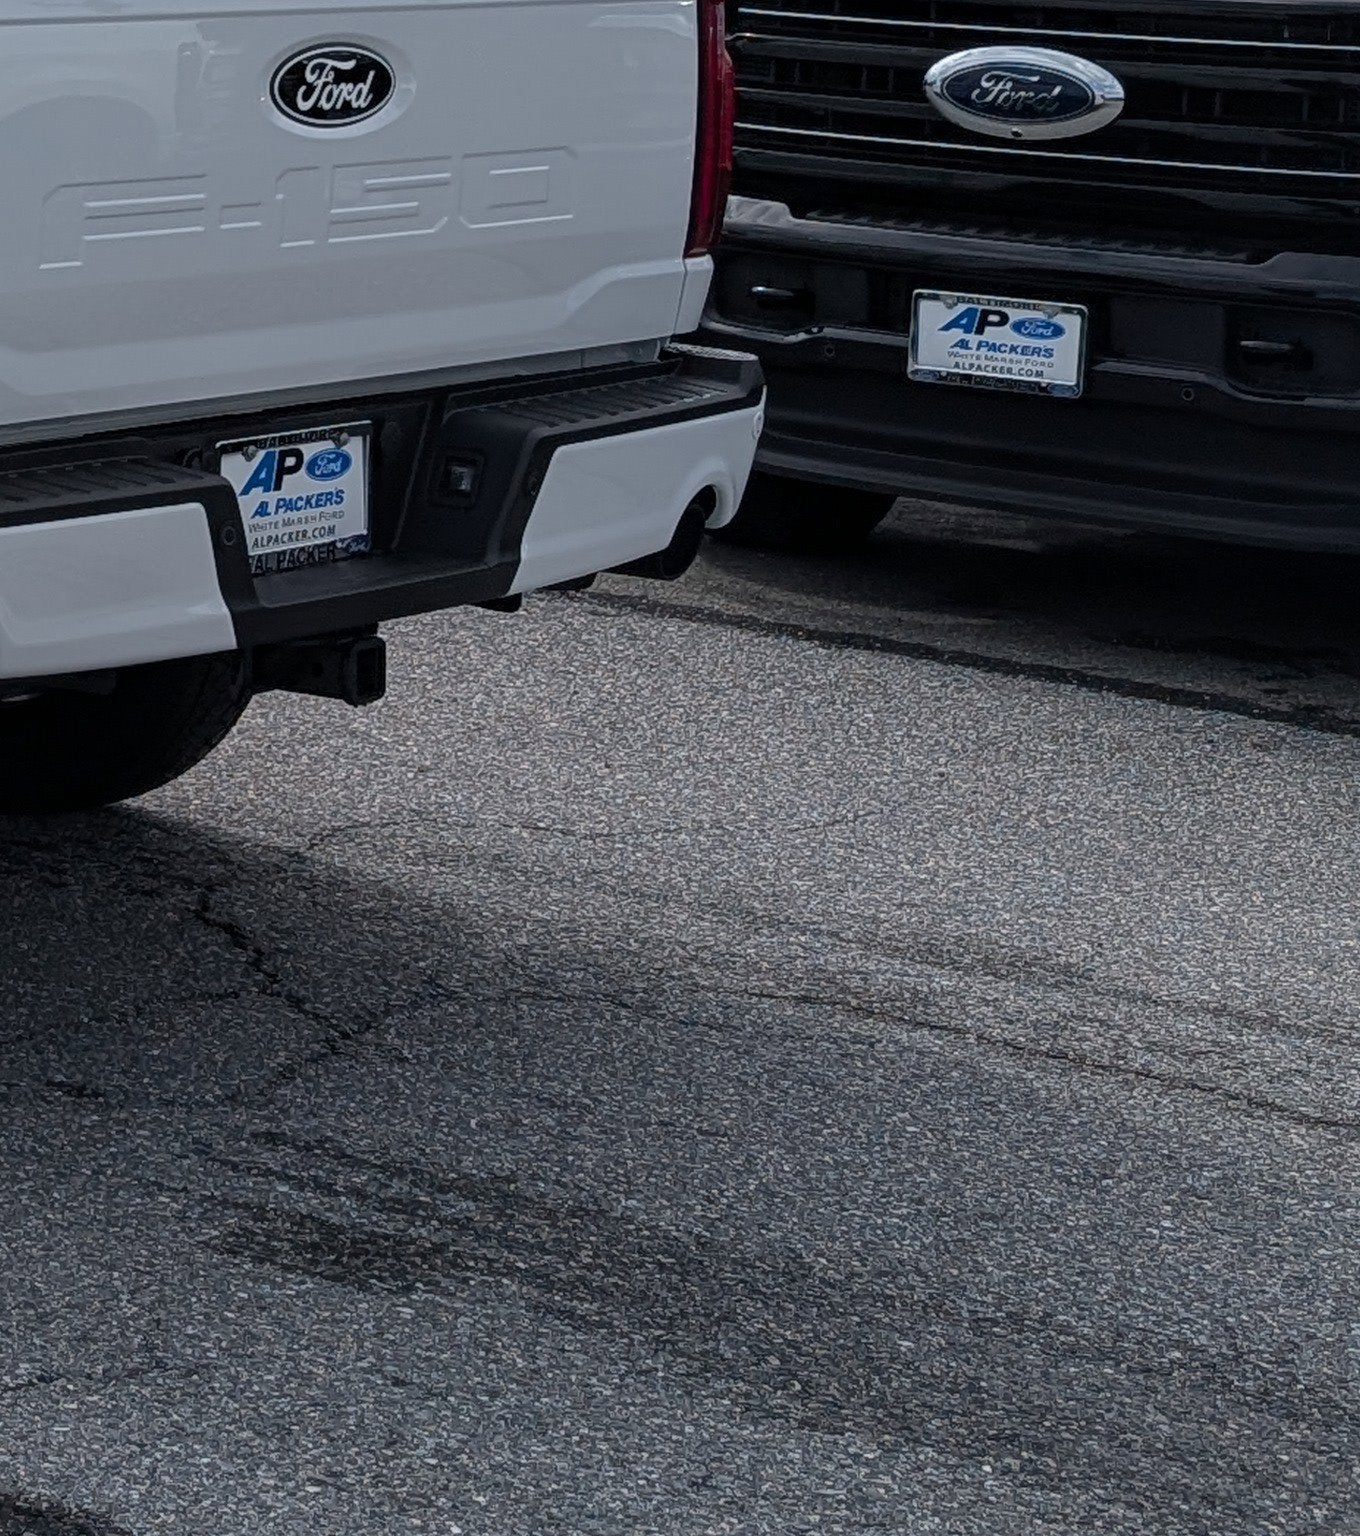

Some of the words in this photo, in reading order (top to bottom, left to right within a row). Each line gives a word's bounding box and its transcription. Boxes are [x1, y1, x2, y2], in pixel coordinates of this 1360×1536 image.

[296, 57, 376, 112] Ford
[970, 70, 1063, 113] Ford
[39, 146, 577, 269] F-150
[937, 307, 1010, 336] AP
[949, 338, 973, 351] AL
[975, 339, 1055, 359] PACKER'S
[953, 361, 1044, 378] ALPACKER.COM
[238, 447, 304, 497] AP
[250, 500, 271, 519] AL
[274, 486, 345, 515] PACKER'S
[251, 524, 336, 549] ALPACKER.COM
